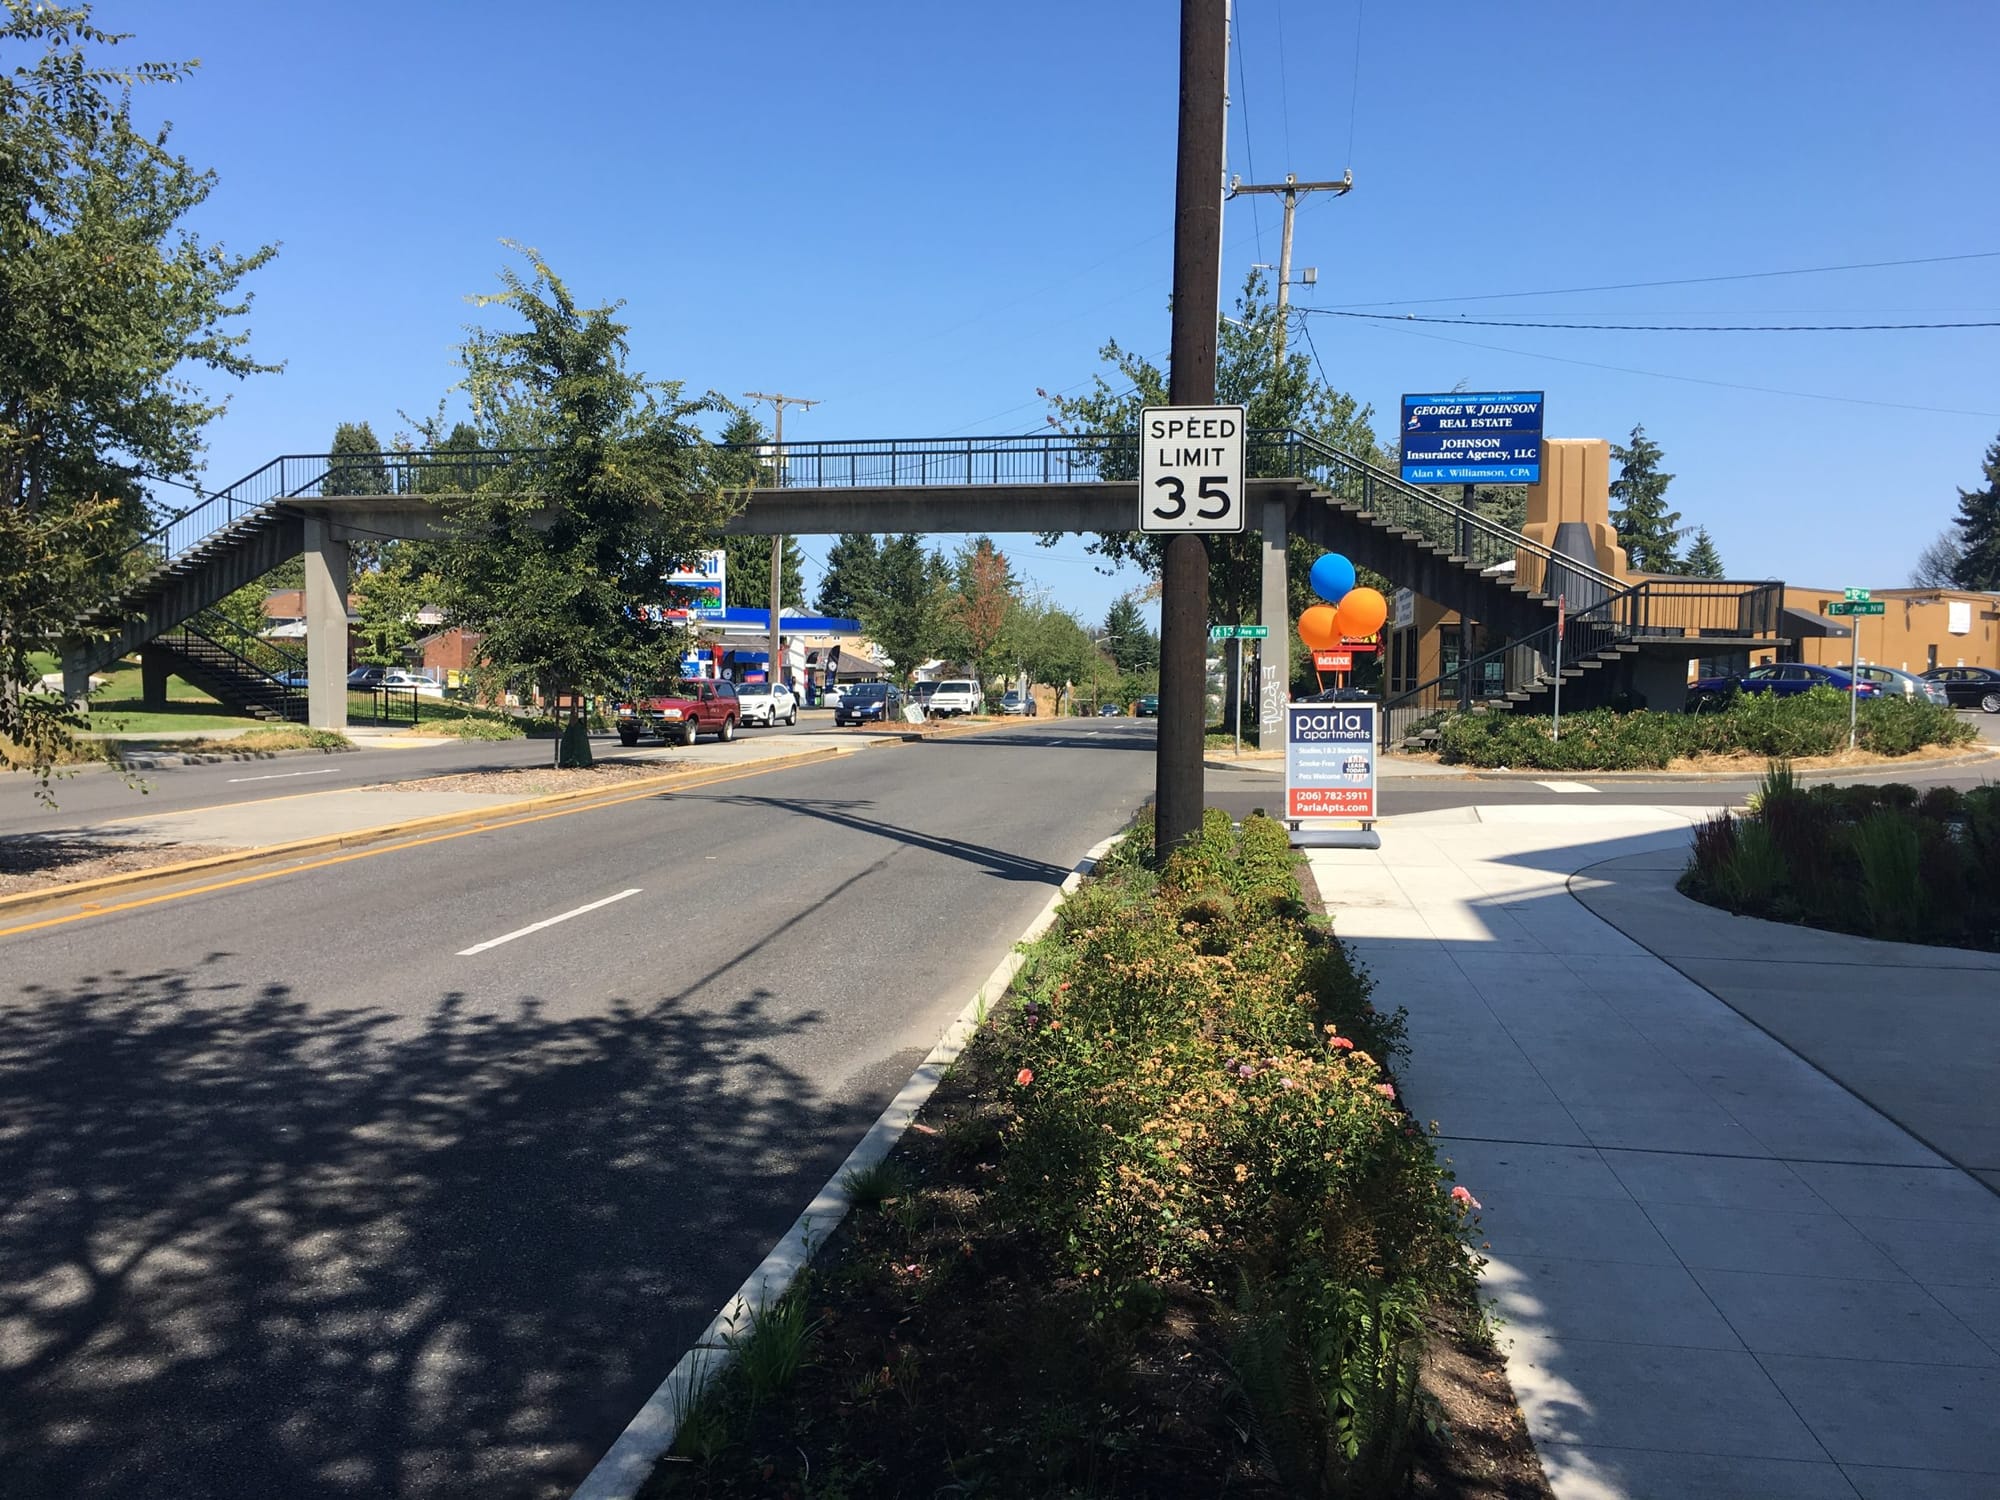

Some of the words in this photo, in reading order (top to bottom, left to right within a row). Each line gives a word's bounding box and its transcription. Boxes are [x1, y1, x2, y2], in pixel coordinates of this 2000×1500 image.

[1413, 405, 1462, 416] GEORGE
[1465, 404, 1476, 414] W.
[1477, 404, 1537, 416] JOHNSON
[1439, 419, 1468, 428] REAL
[1471, 418, 1513, 428] ESTATE
[1151, 419, 1235, 439] SPEED
[1440, 438, 1501, 450] JOHNSON
[1159, 447, 1225, 467] LIMIT
[1407, 450, 1463, 460] Insurance
[1466, 449, 1511, 461] Agency,
[1514, 449, 1536, 458] LLC
[1411, 469, 1433, 478] Alan
[1436, 469, 1446, 477] K.
[1449, 468, 1507, 478] Williamson,
[1510, 468, 1530, 477] CPA
[1152, 476, 1231, 520] 35
[1852, 604, 1867, 613] Ave
[1870, 604, 1884, 613] NW
[1318, 656, 1350, 665] DELUXE
[1295, 711, 1361, 739] parla
[1303, 729, 1371, 741] apartments
[1298, 759, 1336, 767] Smoke-Free
[1298, 772, 1312, 780] Pets
[1312, 772, 1341, 780] Welcome
[1296, 791, 1322, 802] (206)
[1324, 791, 1368, 801] 782-5911
[1296, 803, 1369, 814] ParlaApts.com
